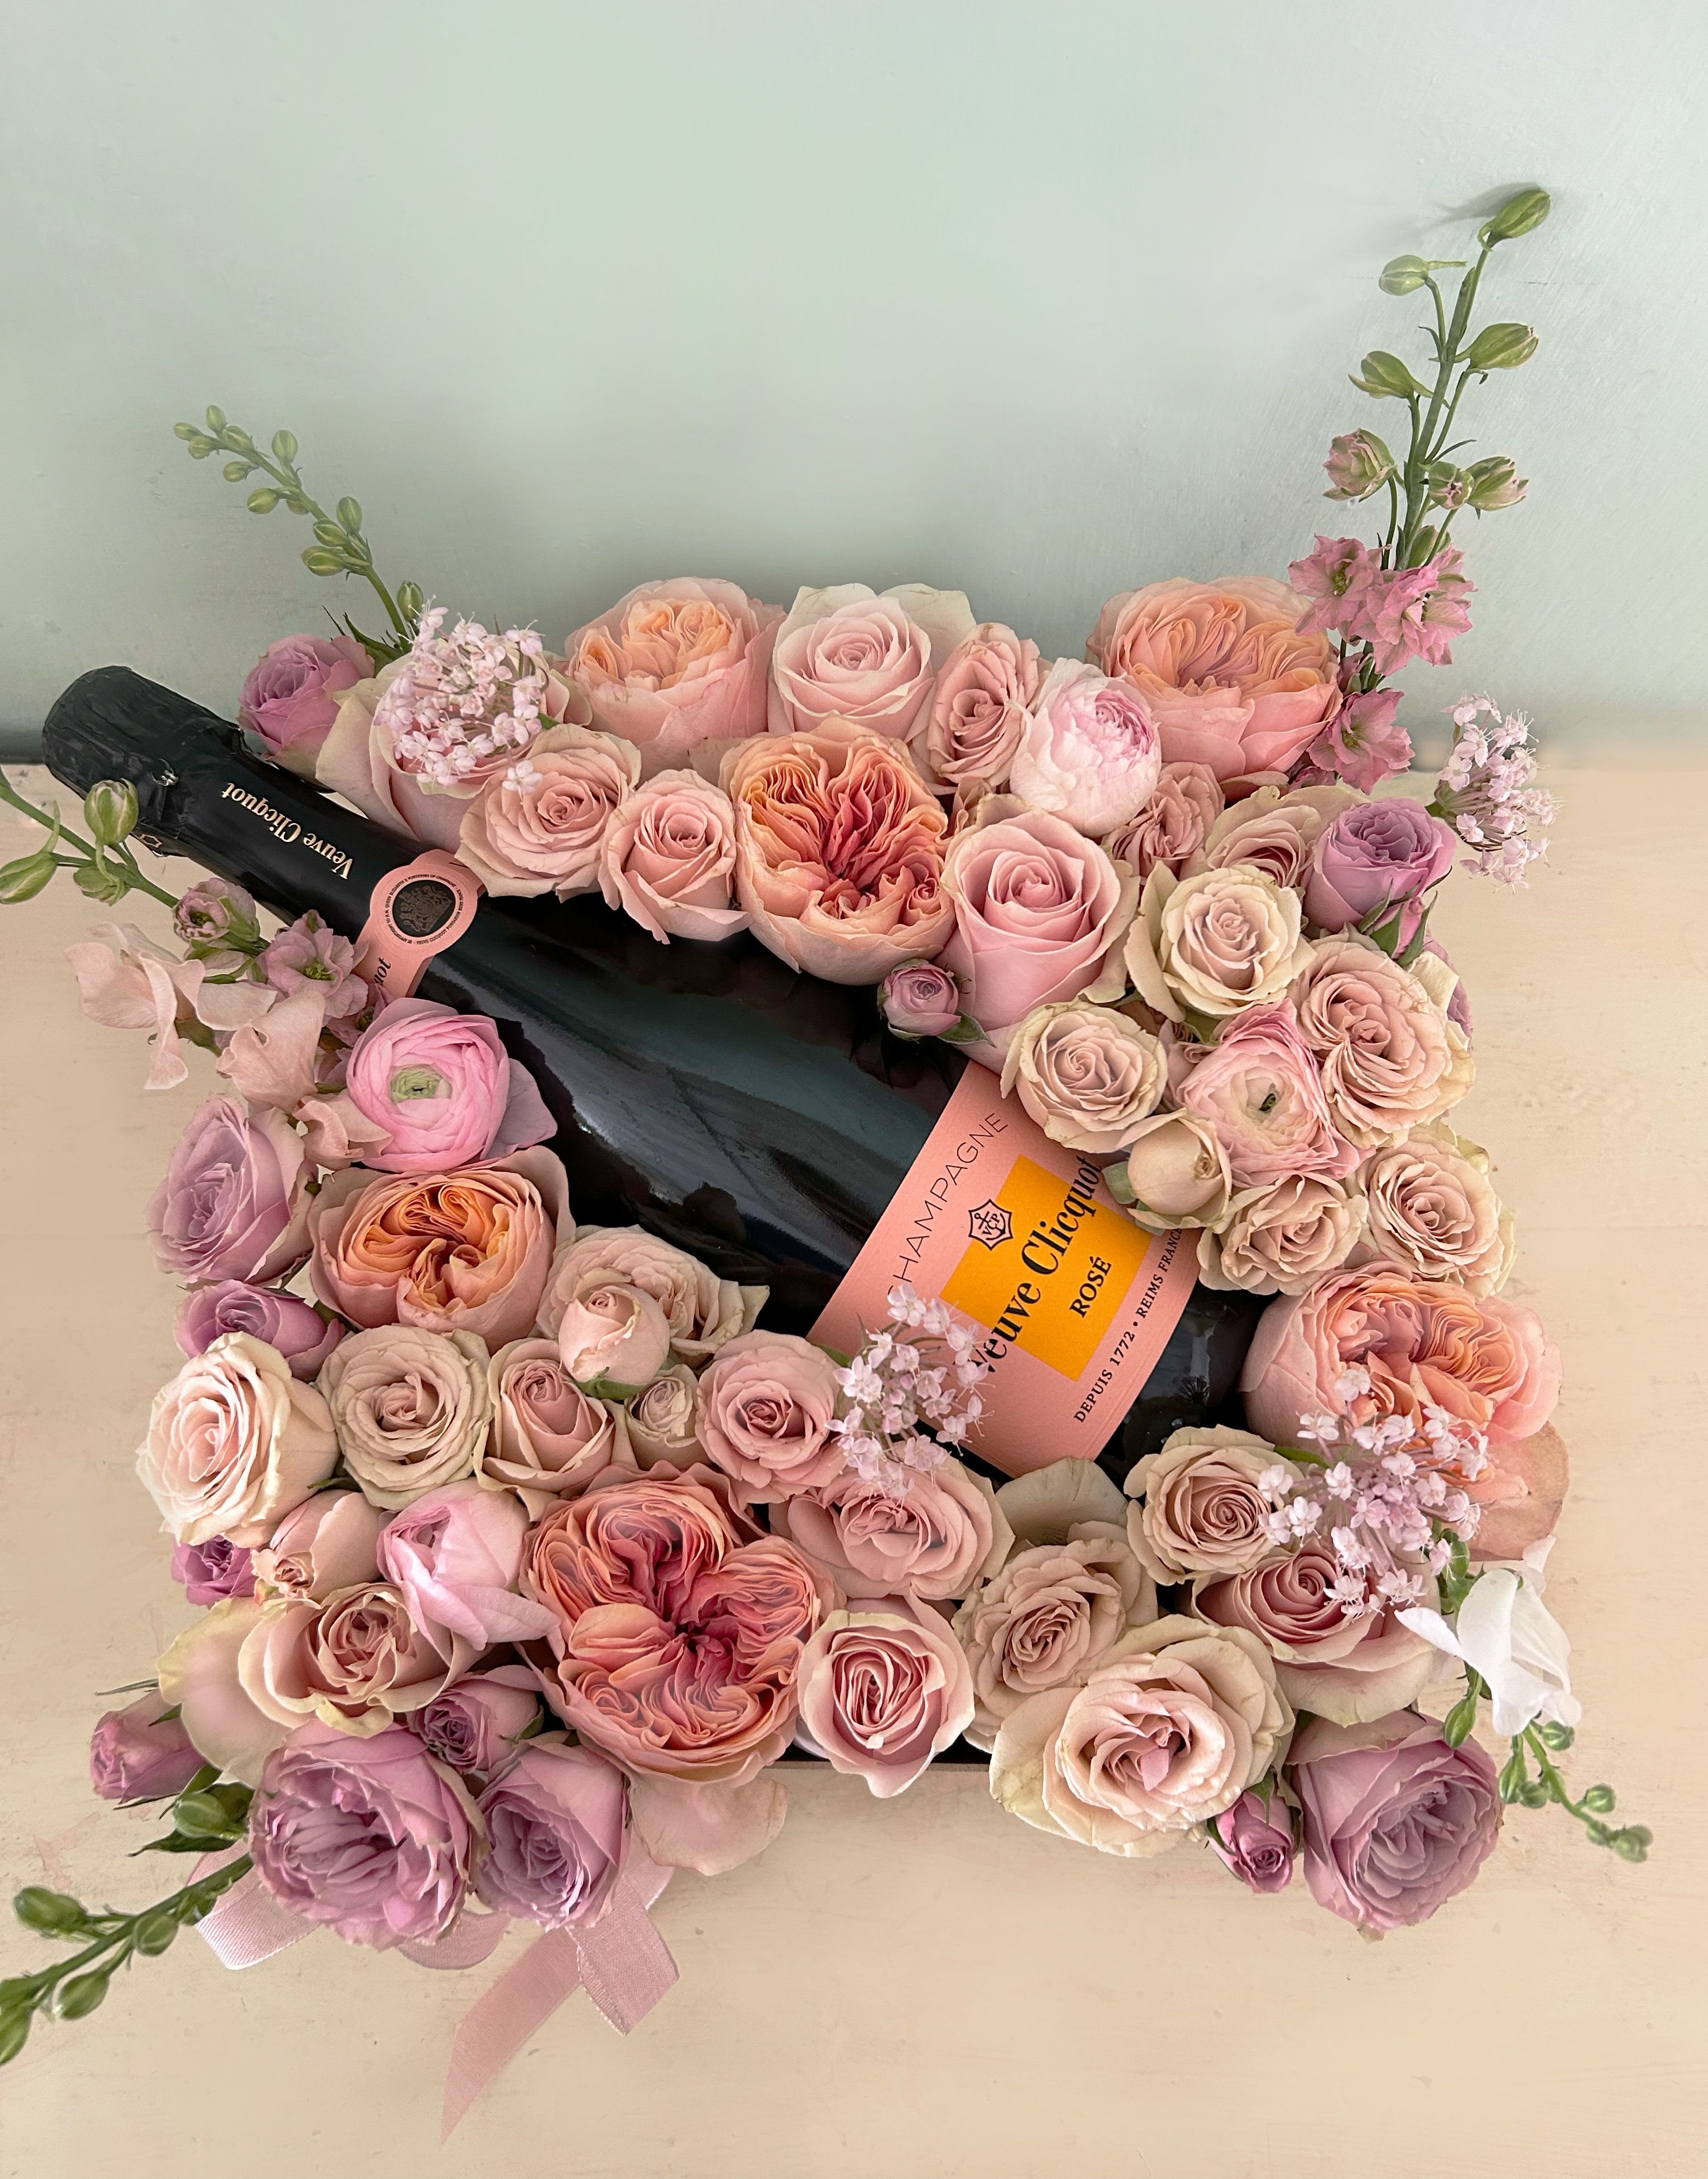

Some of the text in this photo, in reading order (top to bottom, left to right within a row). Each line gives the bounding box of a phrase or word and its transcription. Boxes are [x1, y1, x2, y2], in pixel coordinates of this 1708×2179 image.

[221, 783, 353, 880] Veuve Clicquot
[888, 1113, 1008, 1295] HAMPAGNE
[1021, 1155, 1103, 1275] Clicquot
[1069, 1256, 1112, 1318] ROSÉ
[1073, 1369, 1113, 1423] DEPUIS
[1110, 1331, 1135, 1366] 1772
[1136, 1274, 1163, 1319] REIMS
